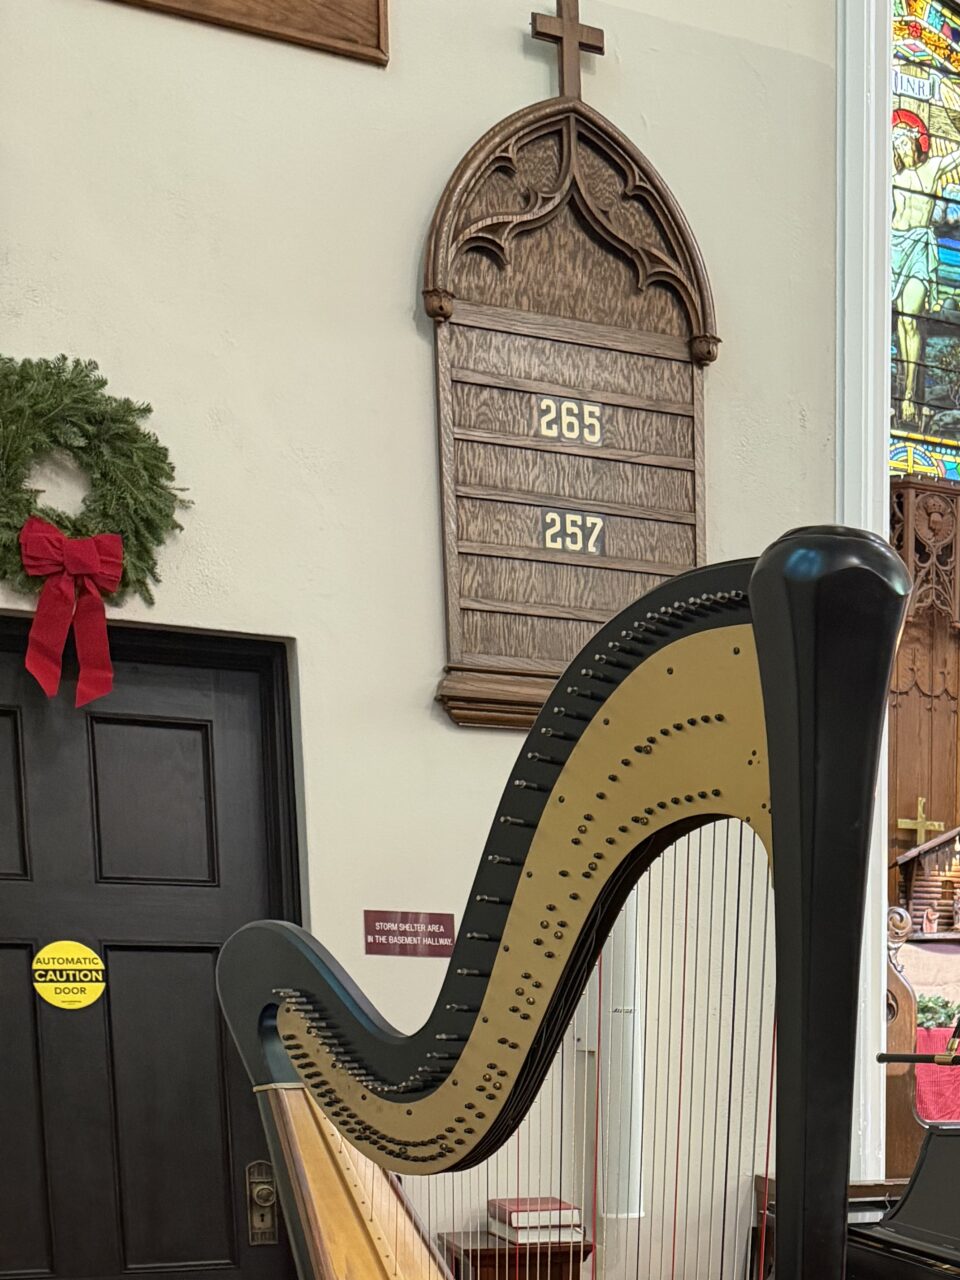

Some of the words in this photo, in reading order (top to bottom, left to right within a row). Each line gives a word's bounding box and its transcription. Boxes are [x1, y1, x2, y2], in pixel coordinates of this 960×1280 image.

[540, 398, 601, 443] 265
[545, 512, 604, 553] 257
[375, 922, 398, 931] STORM
[398, 923, 426, 932] SHELTER
[427, 924, 445, 933] AREA
[367, 935, 374, 943] IN
[375, 935, 388, 944] THE
[388, 936, 421, 945] BASEMENT
[35, 957, 99, 965] AUTOMATIC
[34, 970, 103, 982] CAUTION
[54, 987, 87, 995] DOOR
